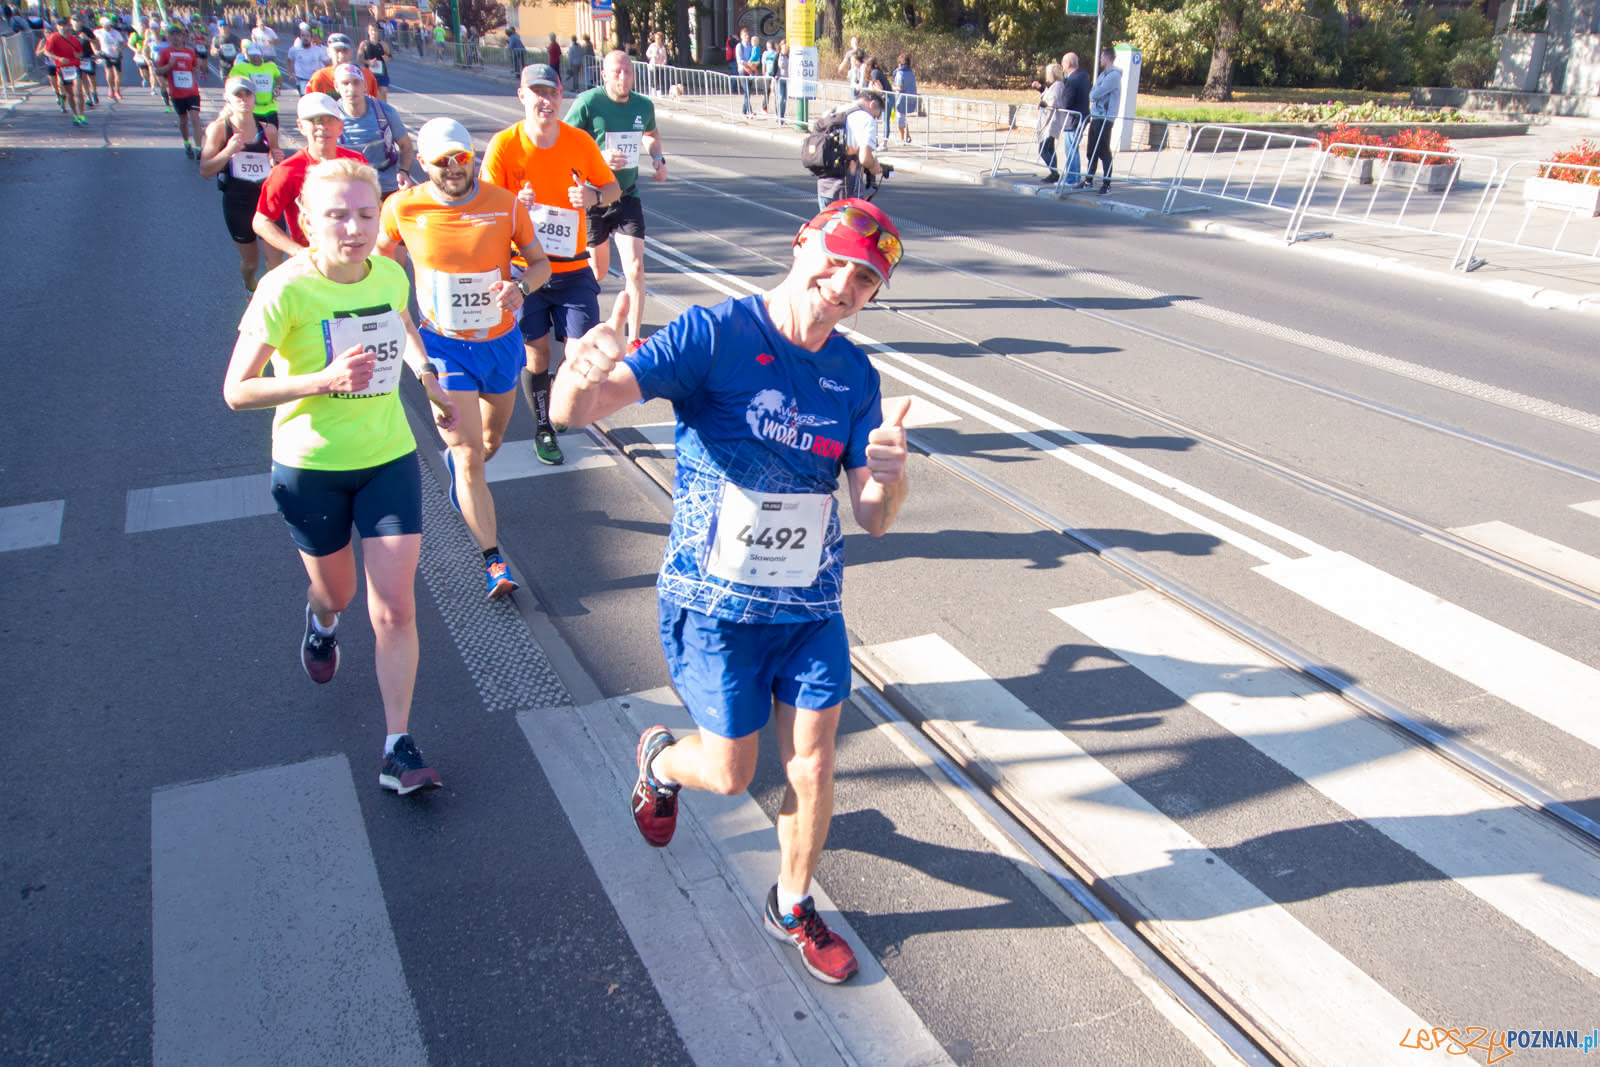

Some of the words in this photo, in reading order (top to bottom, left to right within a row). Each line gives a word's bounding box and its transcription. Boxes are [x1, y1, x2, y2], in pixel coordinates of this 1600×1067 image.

[240, 163, 264, 173] 5701
[538, 222, 571, 238] 2883
[451, 291, 491, 307] 2125
[762, 417, 814, 451] WORLD
[811, 435, 845, 461] RUN
[736, 525, 808, 550] 4492
[749, 553, 787, 562] Sławomir
